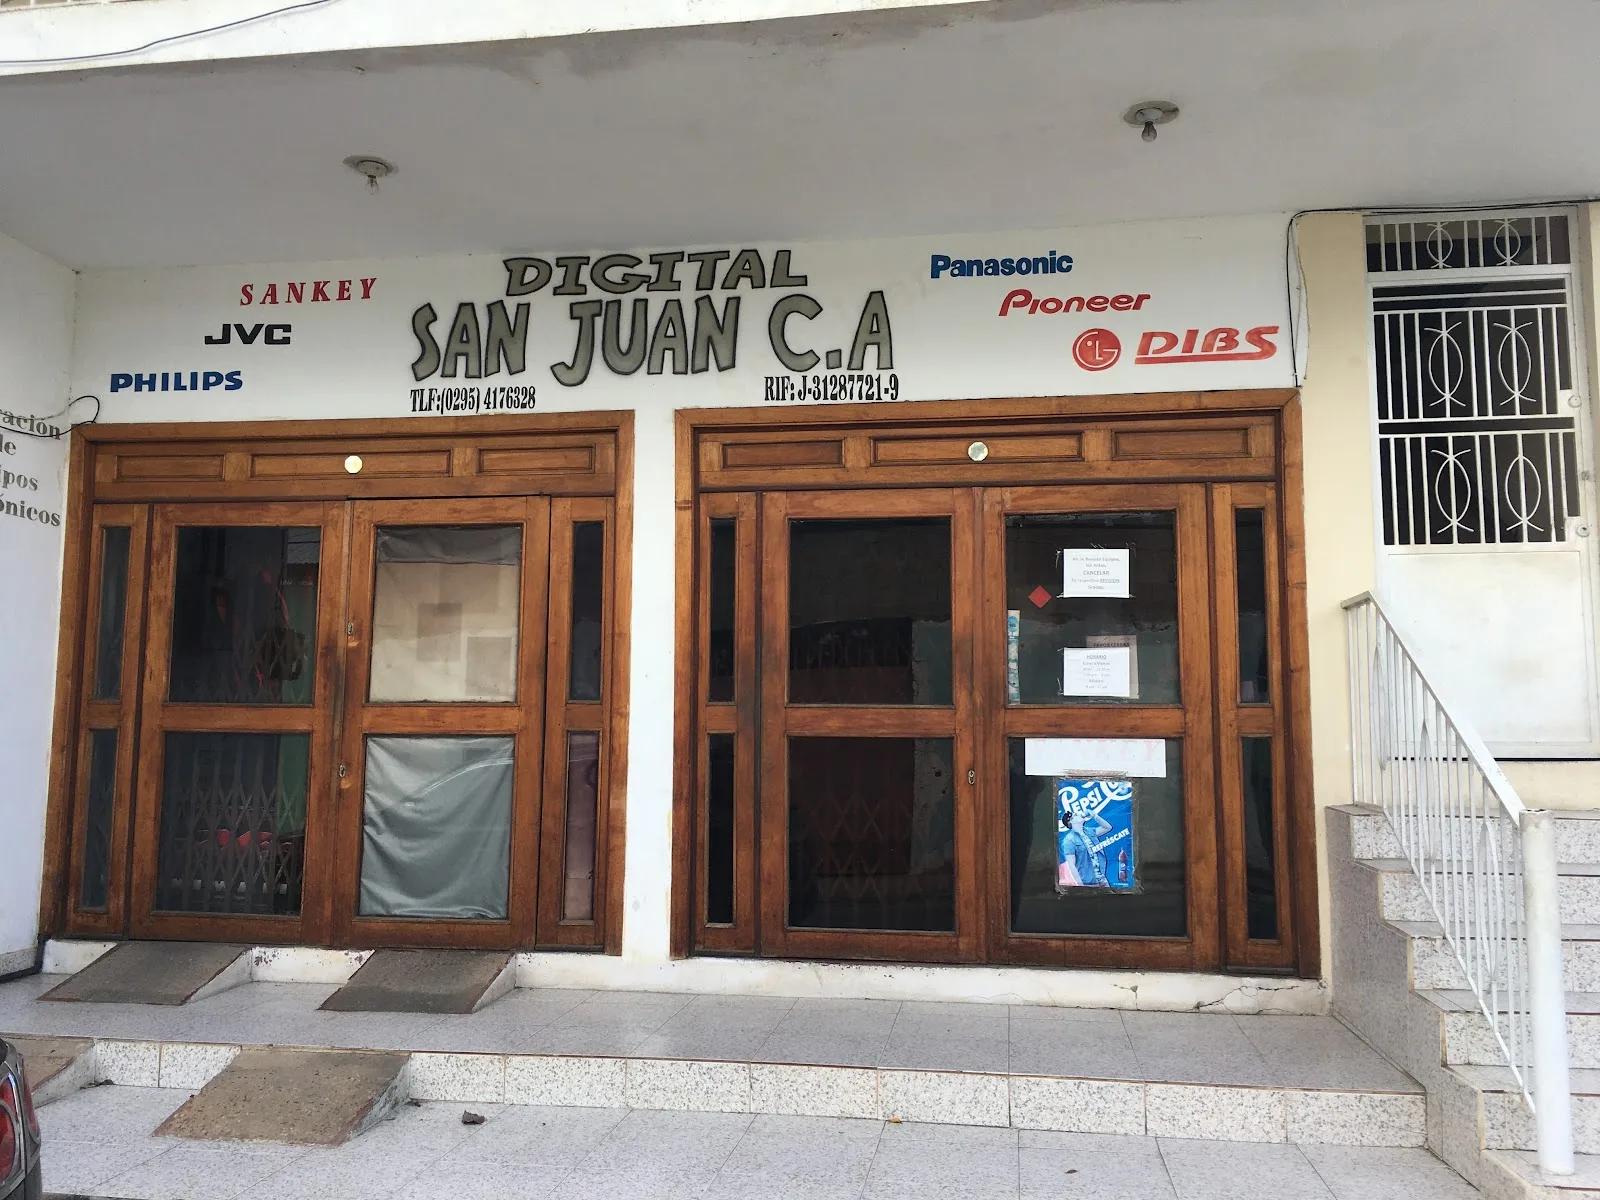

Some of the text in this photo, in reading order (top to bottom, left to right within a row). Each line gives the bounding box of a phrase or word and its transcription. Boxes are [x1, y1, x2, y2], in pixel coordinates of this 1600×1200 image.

[503, 249, 808, 296] DIGITAL
[930, 250, 1074, 279] Panasonic
[240, 277, 377, 306] SANKEY
[998, 288, 1151, 317] Pioneer
[204, 323, 292, 345] JVC
[411, 290, 894, 387] SAN JUAN C.A
[1134, 325, 1280, 364] DIBS
[1074, 329, 1120, 370] LG
[110, 370, 243, 393] PHILIPS
[764, 374, 899, 401] RIF: J-31287721-9
[483, 386, 536, 410] 4176328
